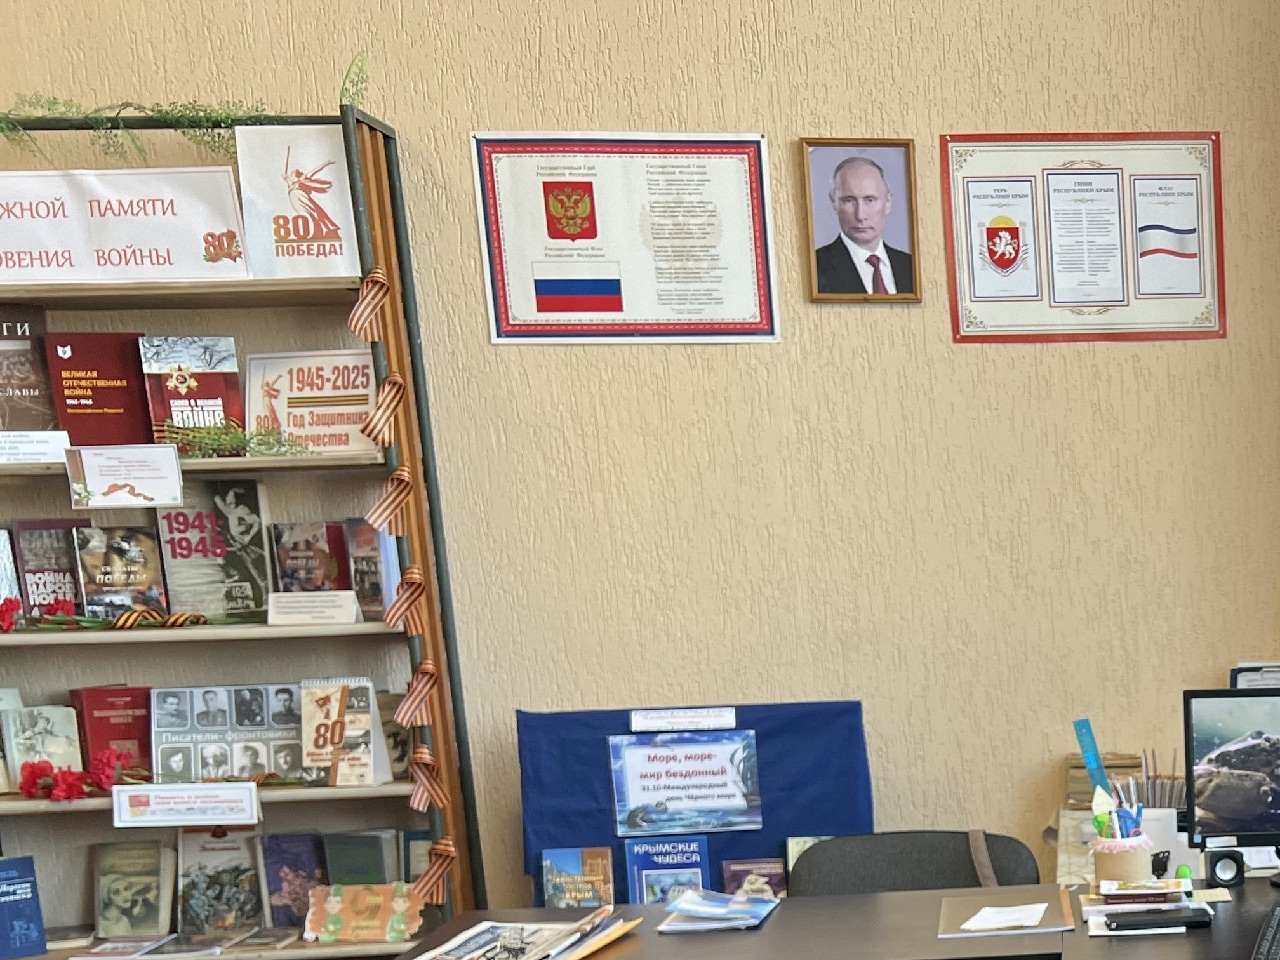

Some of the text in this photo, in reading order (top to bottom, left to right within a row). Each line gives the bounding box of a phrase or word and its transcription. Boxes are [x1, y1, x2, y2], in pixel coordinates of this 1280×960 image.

[88, 198, 178, 218] ПАМЯТИ
[273, 214, 312, 239] 80
[203, 229, 238, 263] 80
[275, 243, 343, 257] ПОБЕДА!
[95, 244, 174, 266] ВОЙНЫ
[61, 370, 98, 378] ВЕЛИКАЯ
[287, 363, 371, 393] 1945-2025
[62, 379, 128, 388] ОТЕЧЕСТВЕННАЯ
[64, 387, 93, 397] ВОЙНА
[287, 410, 306, 429] Год
[165, 536, 227, 560] 1945
[313, 720, 346, 750] 80
[647, 752, 682, 764] Море,
[639, 766, 728, 781] мир бездонный
[634, 841, 699, 855] КРЫМСКИЕ
[653, 852, 701, 865] ЧУДЕСА
[565, 890, 594, 899] КРЫМ
